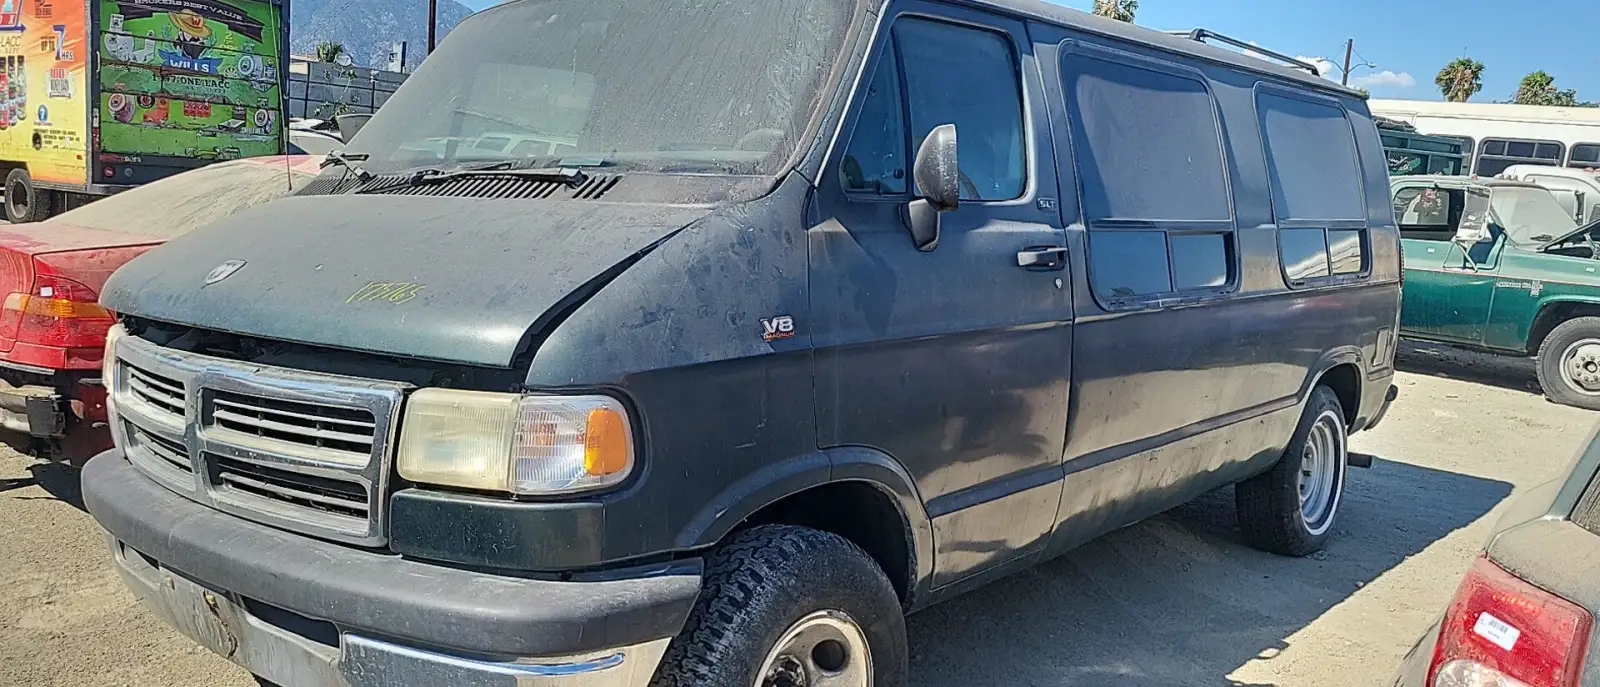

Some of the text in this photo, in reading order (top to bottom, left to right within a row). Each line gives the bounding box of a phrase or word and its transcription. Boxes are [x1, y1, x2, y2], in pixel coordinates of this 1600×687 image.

[183, 1, 207, 10] BEST
[209, 6, 243, 20] VALUE
[53, 24, 66, 60] 7
[1040, 200, 1055, 209] SLT
[760, 315, 794, 334] V8
